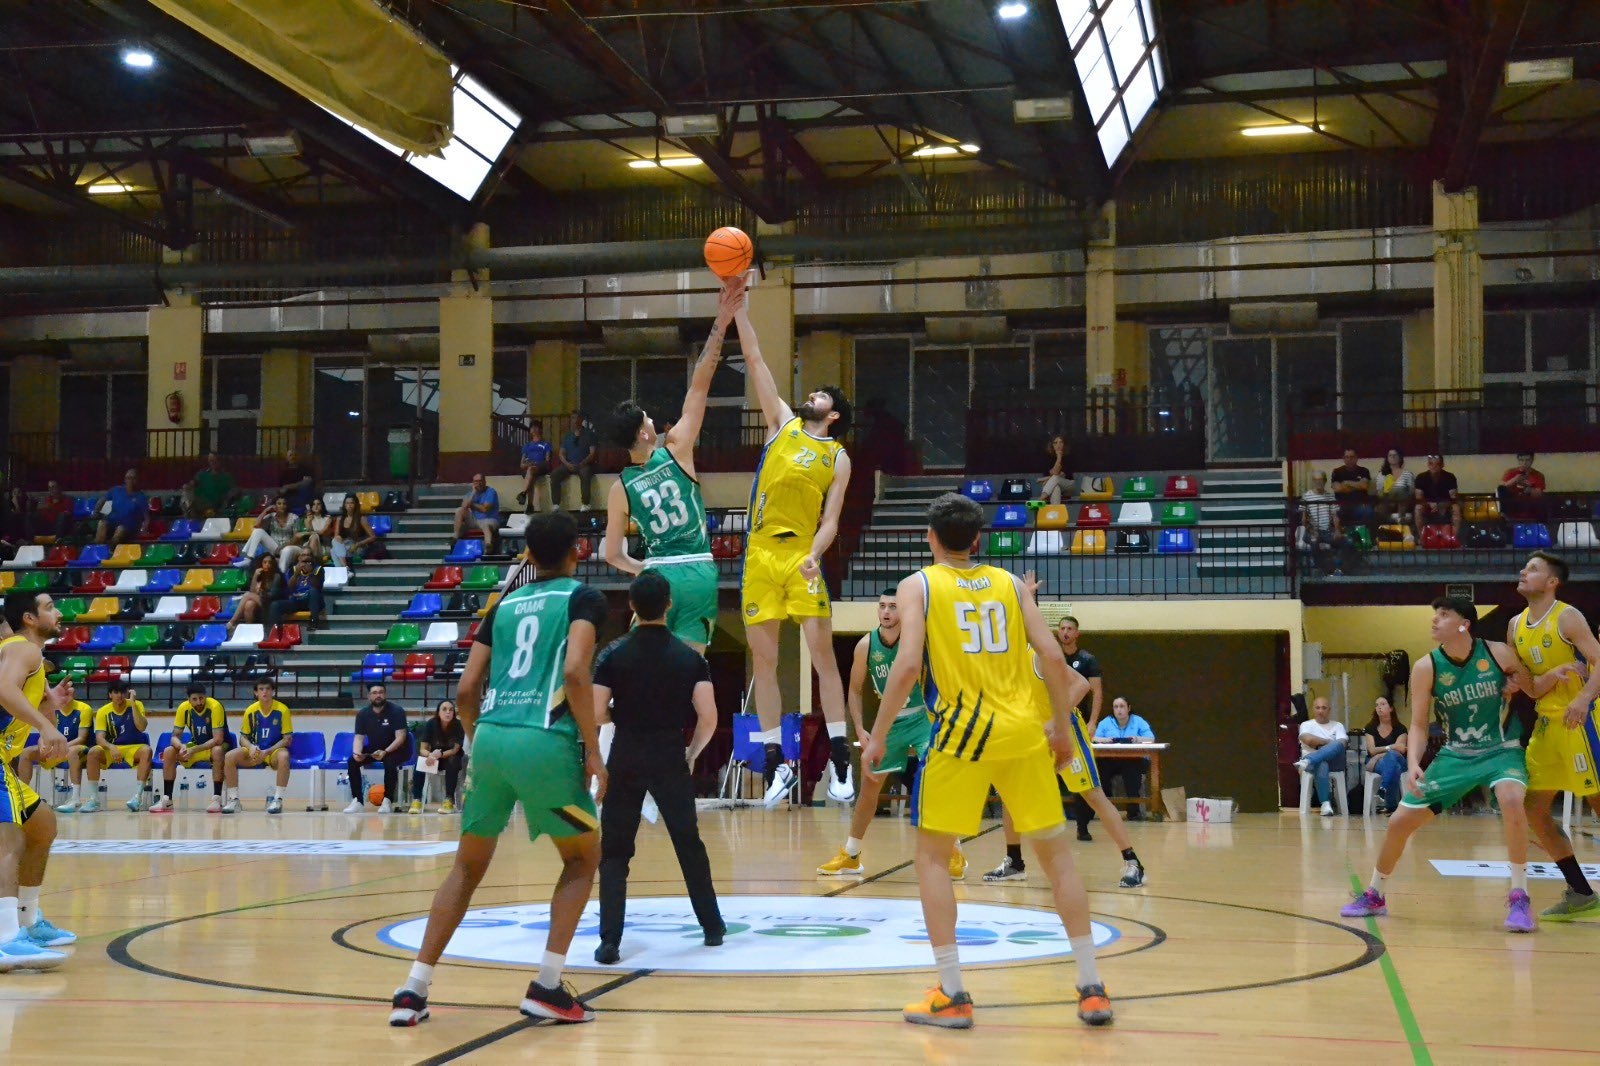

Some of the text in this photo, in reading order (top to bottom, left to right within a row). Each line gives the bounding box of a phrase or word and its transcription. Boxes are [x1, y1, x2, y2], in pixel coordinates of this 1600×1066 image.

[793, 447, 816, 468] 22
[640, 479, 690, 534] 33
[954, 601, 1009, 653] 50
[508, 615, 539, 679] 8
[1464, 681, 1498, 700] ELCHE
[1468, 704, 1479, 722] 7
[261, 728, 270, 738] 17
